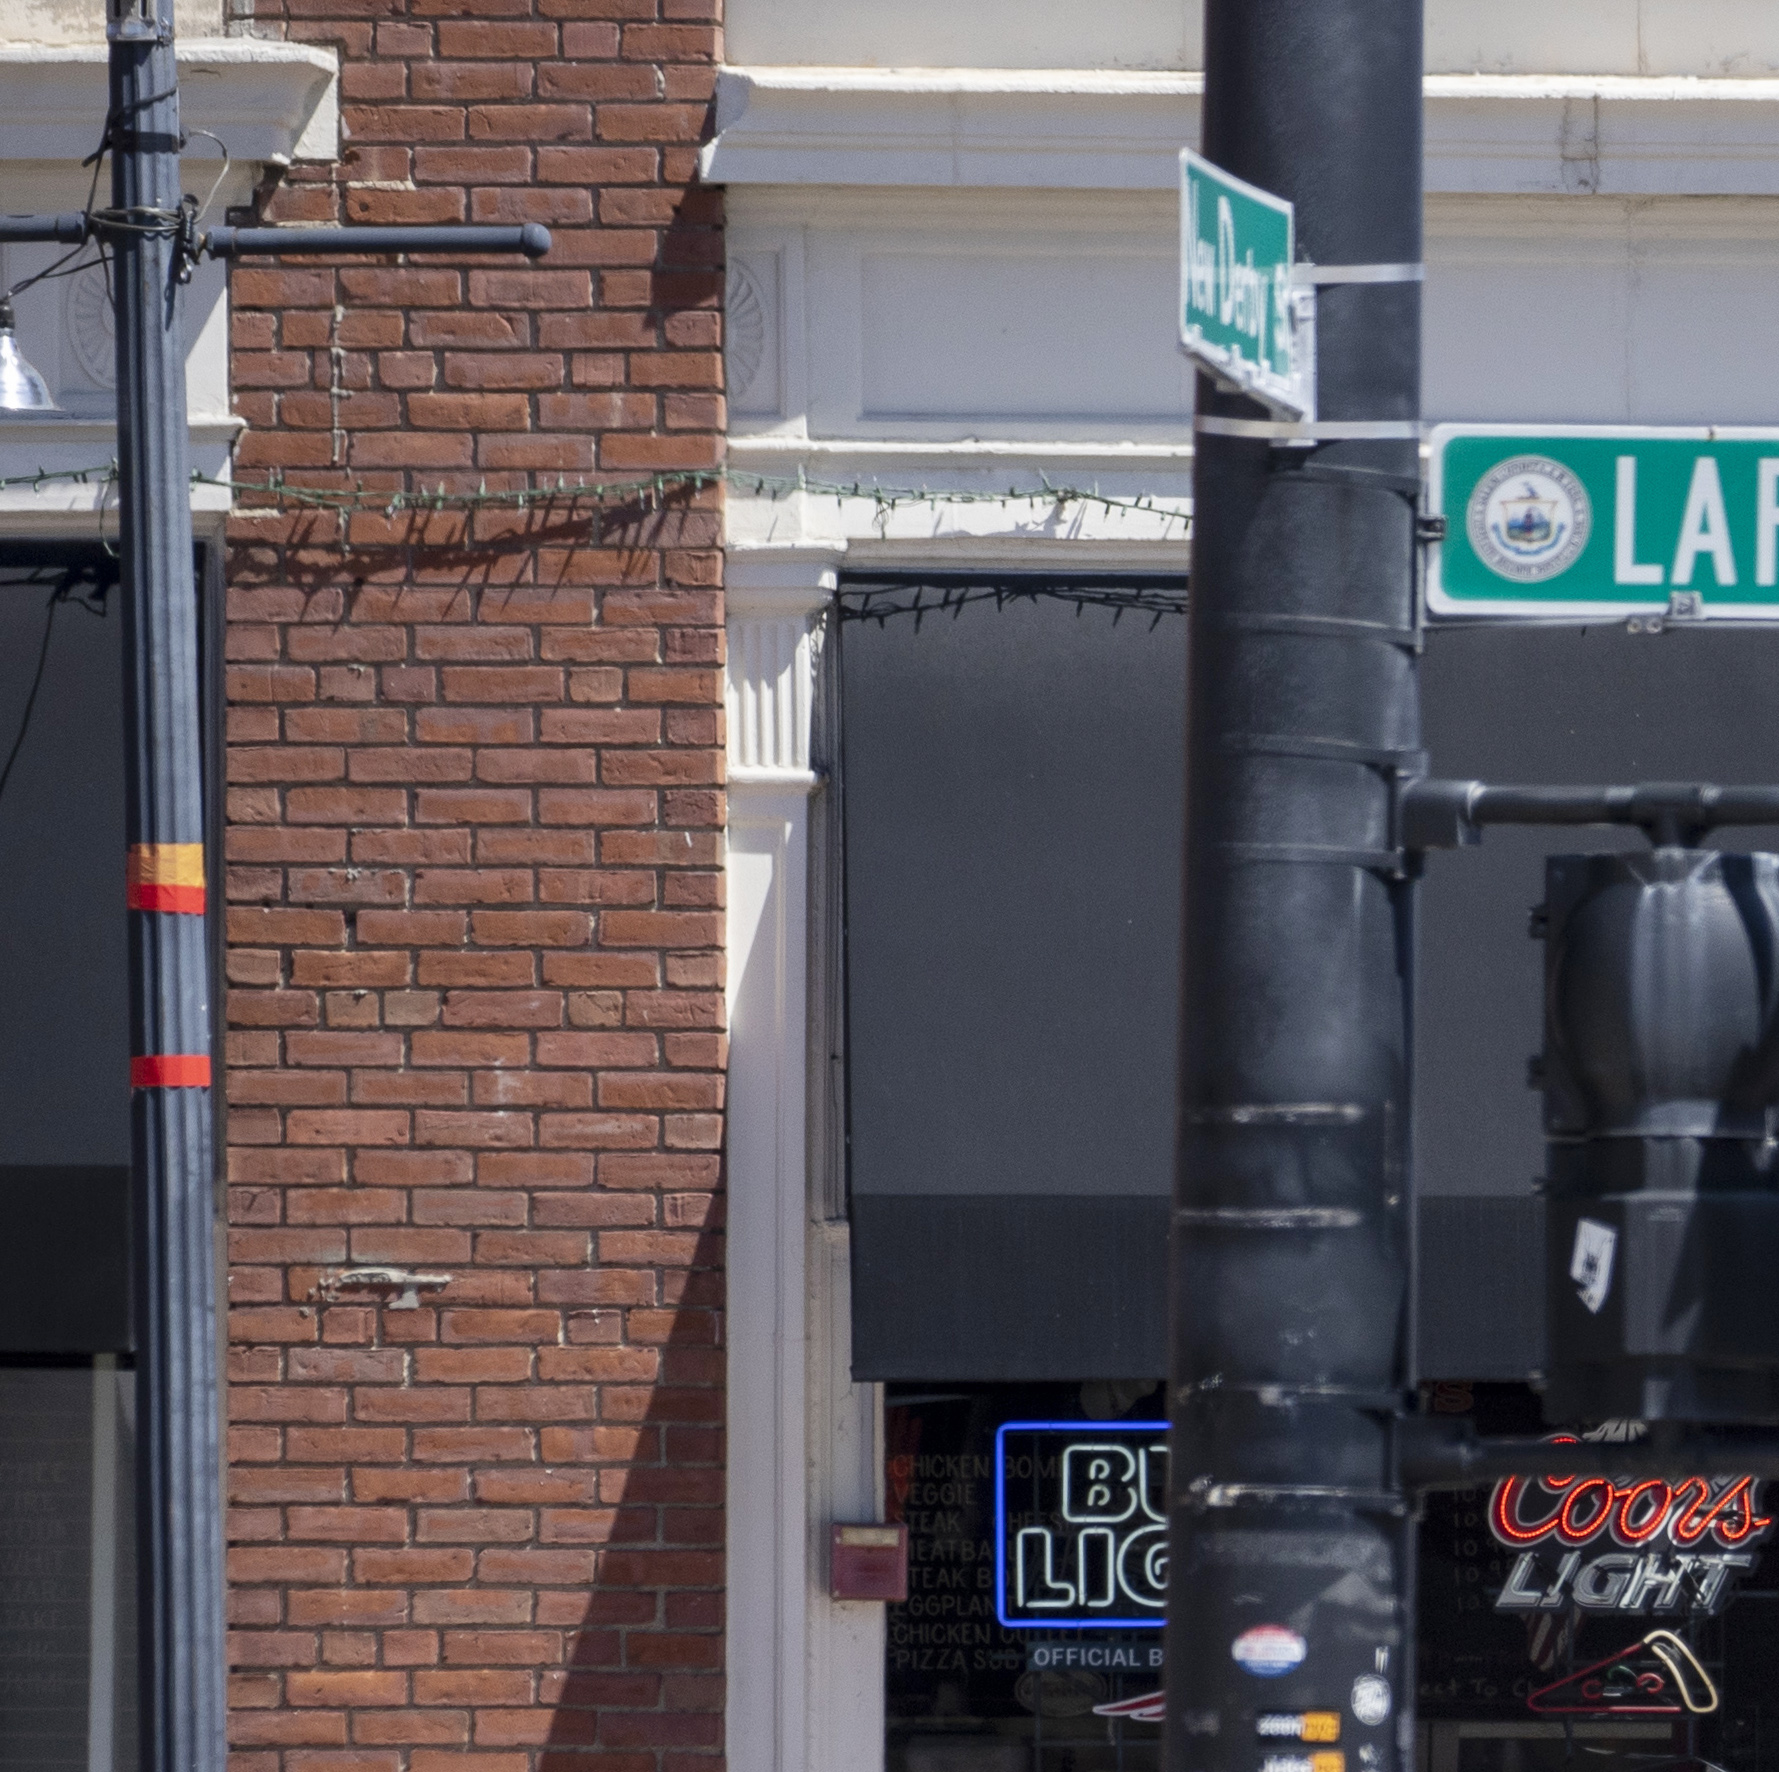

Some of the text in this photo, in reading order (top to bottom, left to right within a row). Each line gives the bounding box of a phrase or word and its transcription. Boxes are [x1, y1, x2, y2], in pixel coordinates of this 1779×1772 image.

[892, 1454, 990, 1479] CHICKEN
[907, 1567, 968, 1589] TEAK
[1016, 1526, 1168, 1608] LIG
[1496, 1552, 1754, 1610] LIGHT
[893, 1623, 991, 1645] CHICKEN
[895, 1648, 967, 1672] PIZZA
[1033, 1647, 1141, 1667] OFFICIAL
